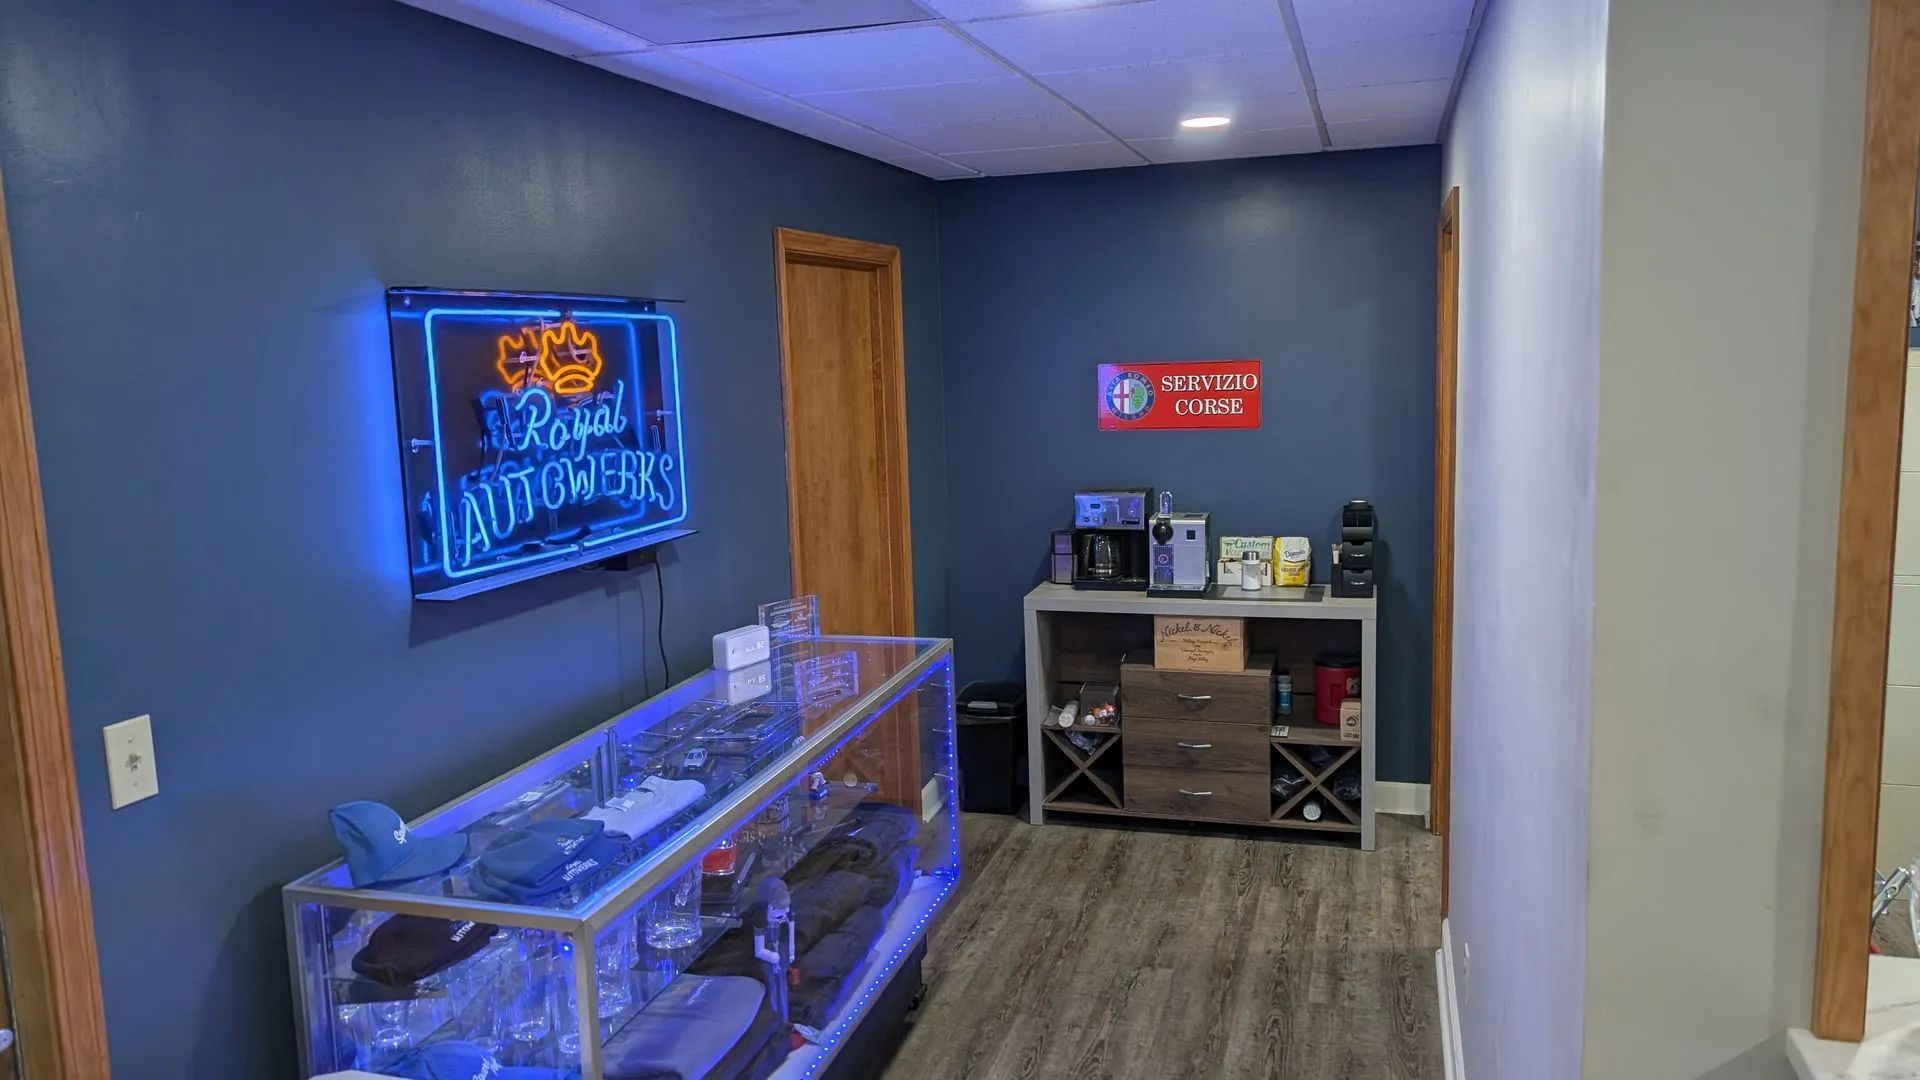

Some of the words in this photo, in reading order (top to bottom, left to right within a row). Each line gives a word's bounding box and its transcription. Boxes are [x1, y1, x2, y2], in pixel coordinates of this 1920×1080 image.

[1127, 372, 1154, 396] ROMEO
[1161, 373, 1258, 392] SERVIZIO
[1175, 398, 1243, 416] CORSE
[514, 380, 627, 461] Royal
[461, 451, 674, 567] AUTOWERKS
[1233, 538, 1270, 549] Custom
[1160, 621, 1191, 642] Nickel
[1201, 623, 1236, 645] Nickel
